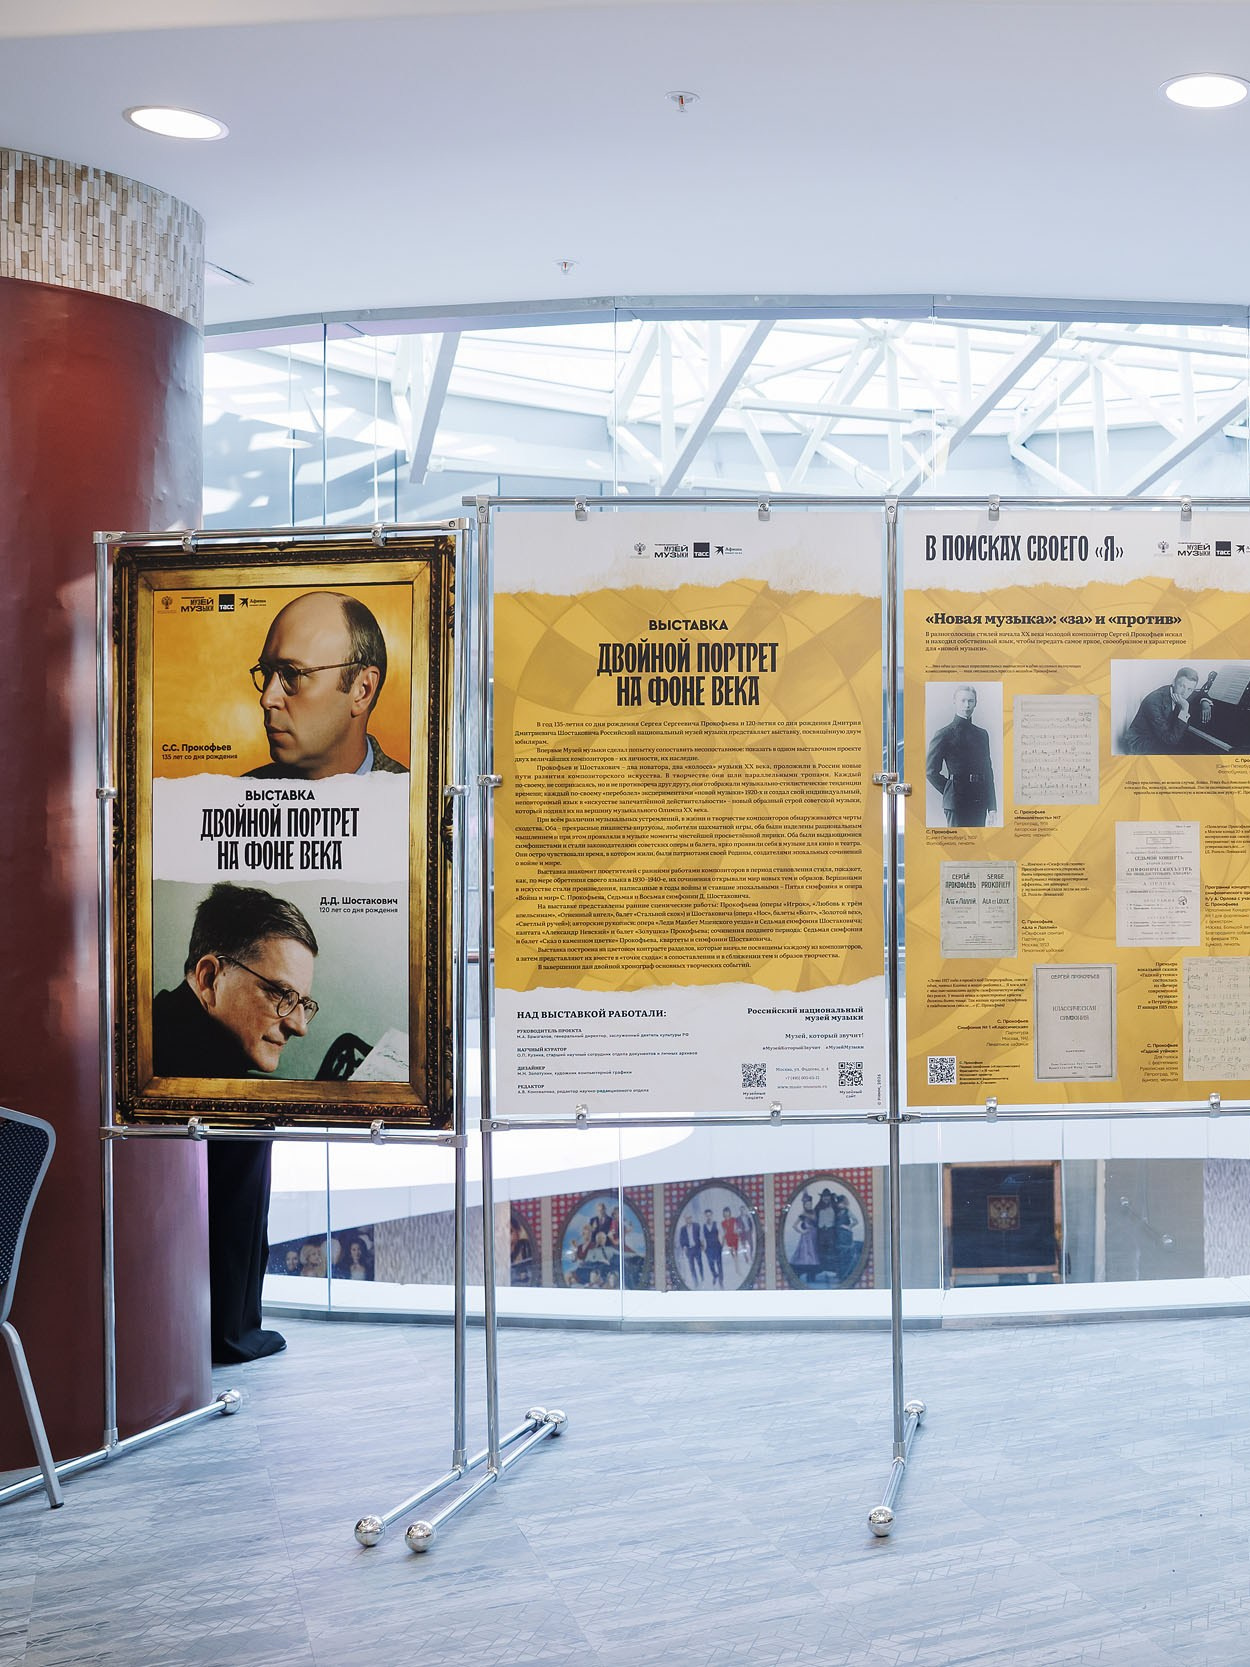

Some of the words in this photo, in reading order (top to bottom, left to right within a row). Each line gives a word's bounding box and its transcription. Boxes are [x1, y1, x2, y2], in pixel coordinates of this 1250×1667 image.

[925, 534, 936, 561] В
[942, 534, 1021, 561] ПОИСКАХ
[1026, 535, 1088, 561] СВОЕГО
[1095, 535, 1124, 561] «Я»
[649, 619, 728, 631] ВЫСТАВКА
[925, 613, 982, 624] «Новая
[984, 615, 1056, 627] музыка»:
[1059, 615, 1092, 624] «за»
[1094, 616, 1105, 624] и
[1108, 616, 1182, 627] «против»
[596, 638, 691, 676] ДВОЙНОЙ
[697, 641, 778, 673] ПОРТРЕТ
[616, 676, 642, 706] НА
[647, 675, 705, 706] ФОНЕ
[711, 675, 759, 705] ВЕКА
[162, 744, 179, 754] С.С.
[181, 743, 231, 752] Прокофьев
[245, 790, 314, 801] ВЫСТАВКА
[200, 804, 281, 841] ДВОЙНОЙ
[286, 807, 360, 838] ПОРТРЕТ
[217, 840, 239, 869] НА
[244, 840, 294, 870] ФОНЕ
[299, 840, 342, 869] ВЕКА
[320, 896, 339, 907] Д.Д.
[541, 1008, 605, 1018] ВЫСТАВКОЙ
[799, 1006, 863, 1015] национальный
